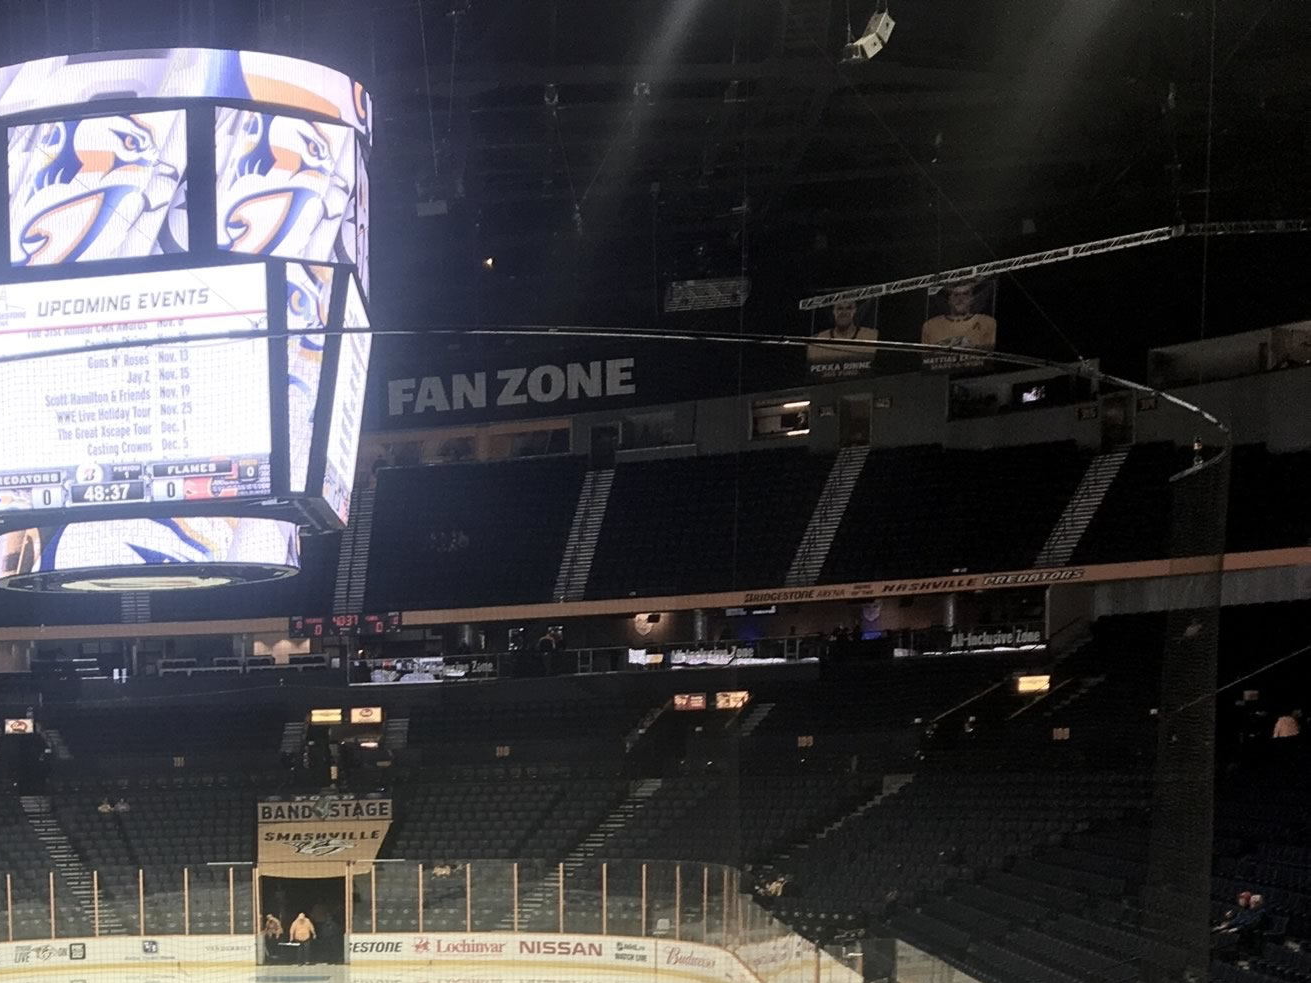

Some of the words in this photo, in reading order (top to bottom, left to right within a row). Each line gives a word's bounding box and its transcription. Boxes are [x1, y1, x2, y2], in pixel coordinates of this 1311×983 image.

[37, 295, 131, 317] UPCOMING
[137, 287, 210, 309] EVENTS
[87, 356, 109, 369] Guns
[124, 353, 150, 367] Roses
[158, 351, 177, 363] Nov.
[180, 350, 189, 361] 13
[810, 363, 841, 373] PEKKA
[843, 361, 872, 371] RINNE
[127, 370, 141, 385] Jay
[145, 370, 150, 383] Z
[159, 369, 178, 381] Nov.
[180, 367, 190, 379] 15
[45, 394, 68, 407] Scott
[70, 392, 109, 405] Hamilton
[111, 391, 117, 402] &
[119, 388, 151, 402] Friends
[160, 386, 178, 398] Nov.
[181, 384, 191, 397] 19
[388, 371, 487, 415] FAN
[497, 358, 636, 406] ZONE
[56, 410, 76, 424] WWE
[78, 409, 95, 423] Live
[98, 408, 130, 422] Holiday
[133, 406, 151, 419] Tour
[160, 404, 179, 416] Nov.
[182, 402, 193, 414] 25
[58, 428, 72, 441] The
[75, 426, 98, 439] Great
[101, 424, 131, 440] Xscape
[134, 423, 152, 436] Tour
[161, 421, 179, 433] Dec.
[87, 444, 119, 457] Casting
[122, 441, 153, 454] Crowns
[162, 438, 180, 450] Dec.
[183, 437, 189, 449] 5
[113, 464, 140, 472] PERIOD
[167, 462, 217, 475] FLAMES
[247, 466, 254, 477] 0
[42, 489, 52, 507] 0
[83, 483, 131, 501] 48:37
[166, 482, 176, 498] 0
[882, 577, 978, 593] NASHVILLE
[982, 568, 1086, 585] PREDATORS
[745, 589, 814, 603] BRIDGESTONE
[951, 631, 1013, 648] All-Inclusive
[1016, 629, 1041, 644] Zone
[261, 804, 314, 820] BAND
[329, 802, 390, 817] STAGE
[264, 829, 381, 842] SMASHVILLE
[436, 938, 506, 954] Lochinvar
[519, 940, 604, 957] NISSAN
